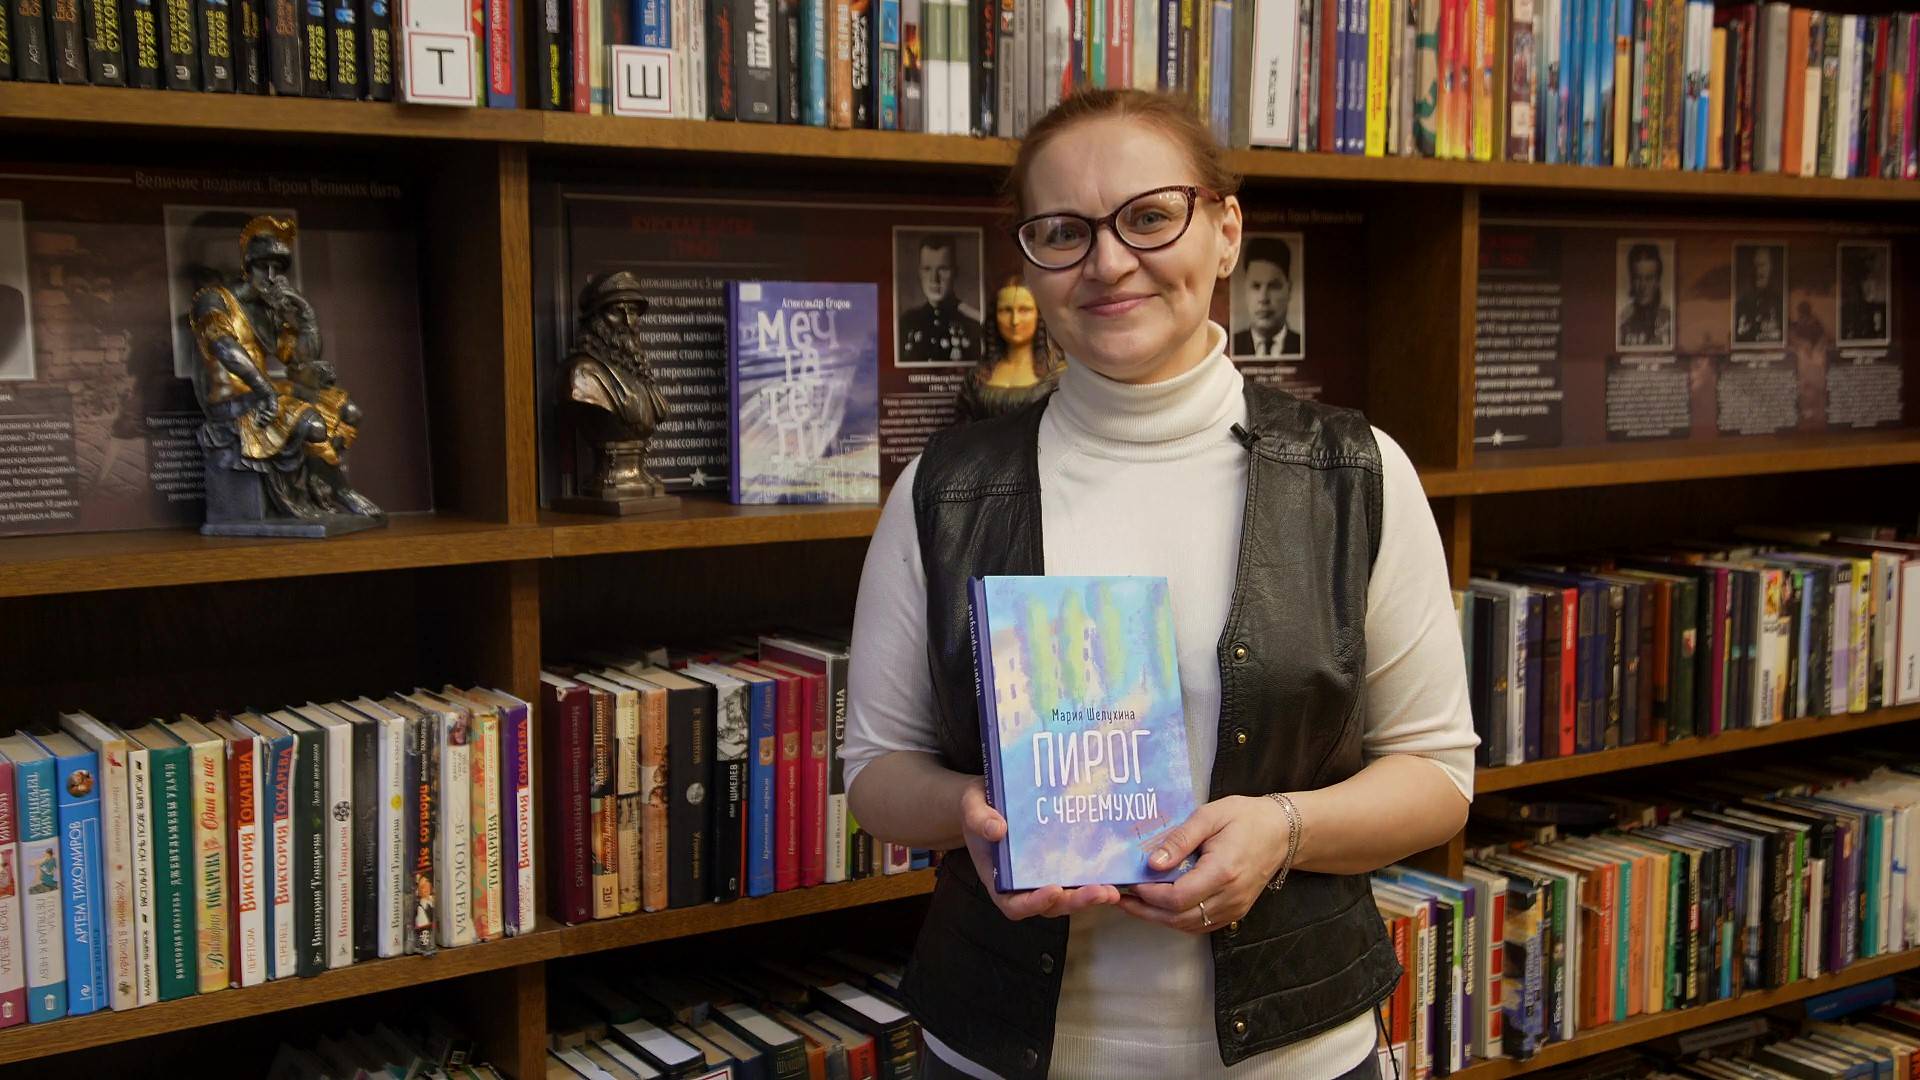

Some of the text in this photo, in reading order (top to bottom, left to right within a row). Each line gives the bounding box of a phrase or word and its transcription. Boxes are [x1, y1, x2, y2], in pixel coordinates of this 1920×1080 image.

[425, 47, 455, 85] Т
[626, 63, 662, 101] Ш
[642, 315, 692, 327] чественной
[675, 297, 701, 308] одним
[758, 308, 841, 357] Меч
[661, 365, 716, 381] перехватить
[678, 349, 703, 361] стало
[677, 456, 706, 470] солдат
[594, 699, 607, 786] Михаил Шишкин
[835, 688, 846, 741] СТРАНА
[1052, 707, 1136, 725] Мария Шелухина
[165, 762, 177, 798] УДАЧИ
[238, 752, 255, 829] ТОКАРЕВА
[274, 747, 293, 822] ТОКАРЕВА
[729, 763, 738, 802] ШМЕЛЕВ
[1032, 728, 1151, 788] ПИРОГ
[201, 756, 219, 832] Один из нас
[417, 783, 432, 872] Не сотвори
[516, 719, 531, 870] ВИКТОРИЯ ТОКАРЕВА
[1036, 786, 1158, 825] С ЧЕРЕМУХОЙ
[167, 800, 182, 887] ДЖЕНТЛЬМЕНЫ
[239, 831, 257, 913] ВИКТОРИЯ
[274, 825, 290, 906] ВИКТОРИЯ
[391, 818, 402, 930] Виктория Токарева
[487, 814, 499, 889] ТОКАРЕВА
[71, 820, 90, 944] АРТЕМ ТИХОМИРОВ
[205, 852, 222, 909] ТОКАРЕВА
[311, 833, 324, 947] Виктория Токарева
[336, 826, 349, 938] Виктория Токарева
[454, 842, 468, 936] ТОКАРЕВА
